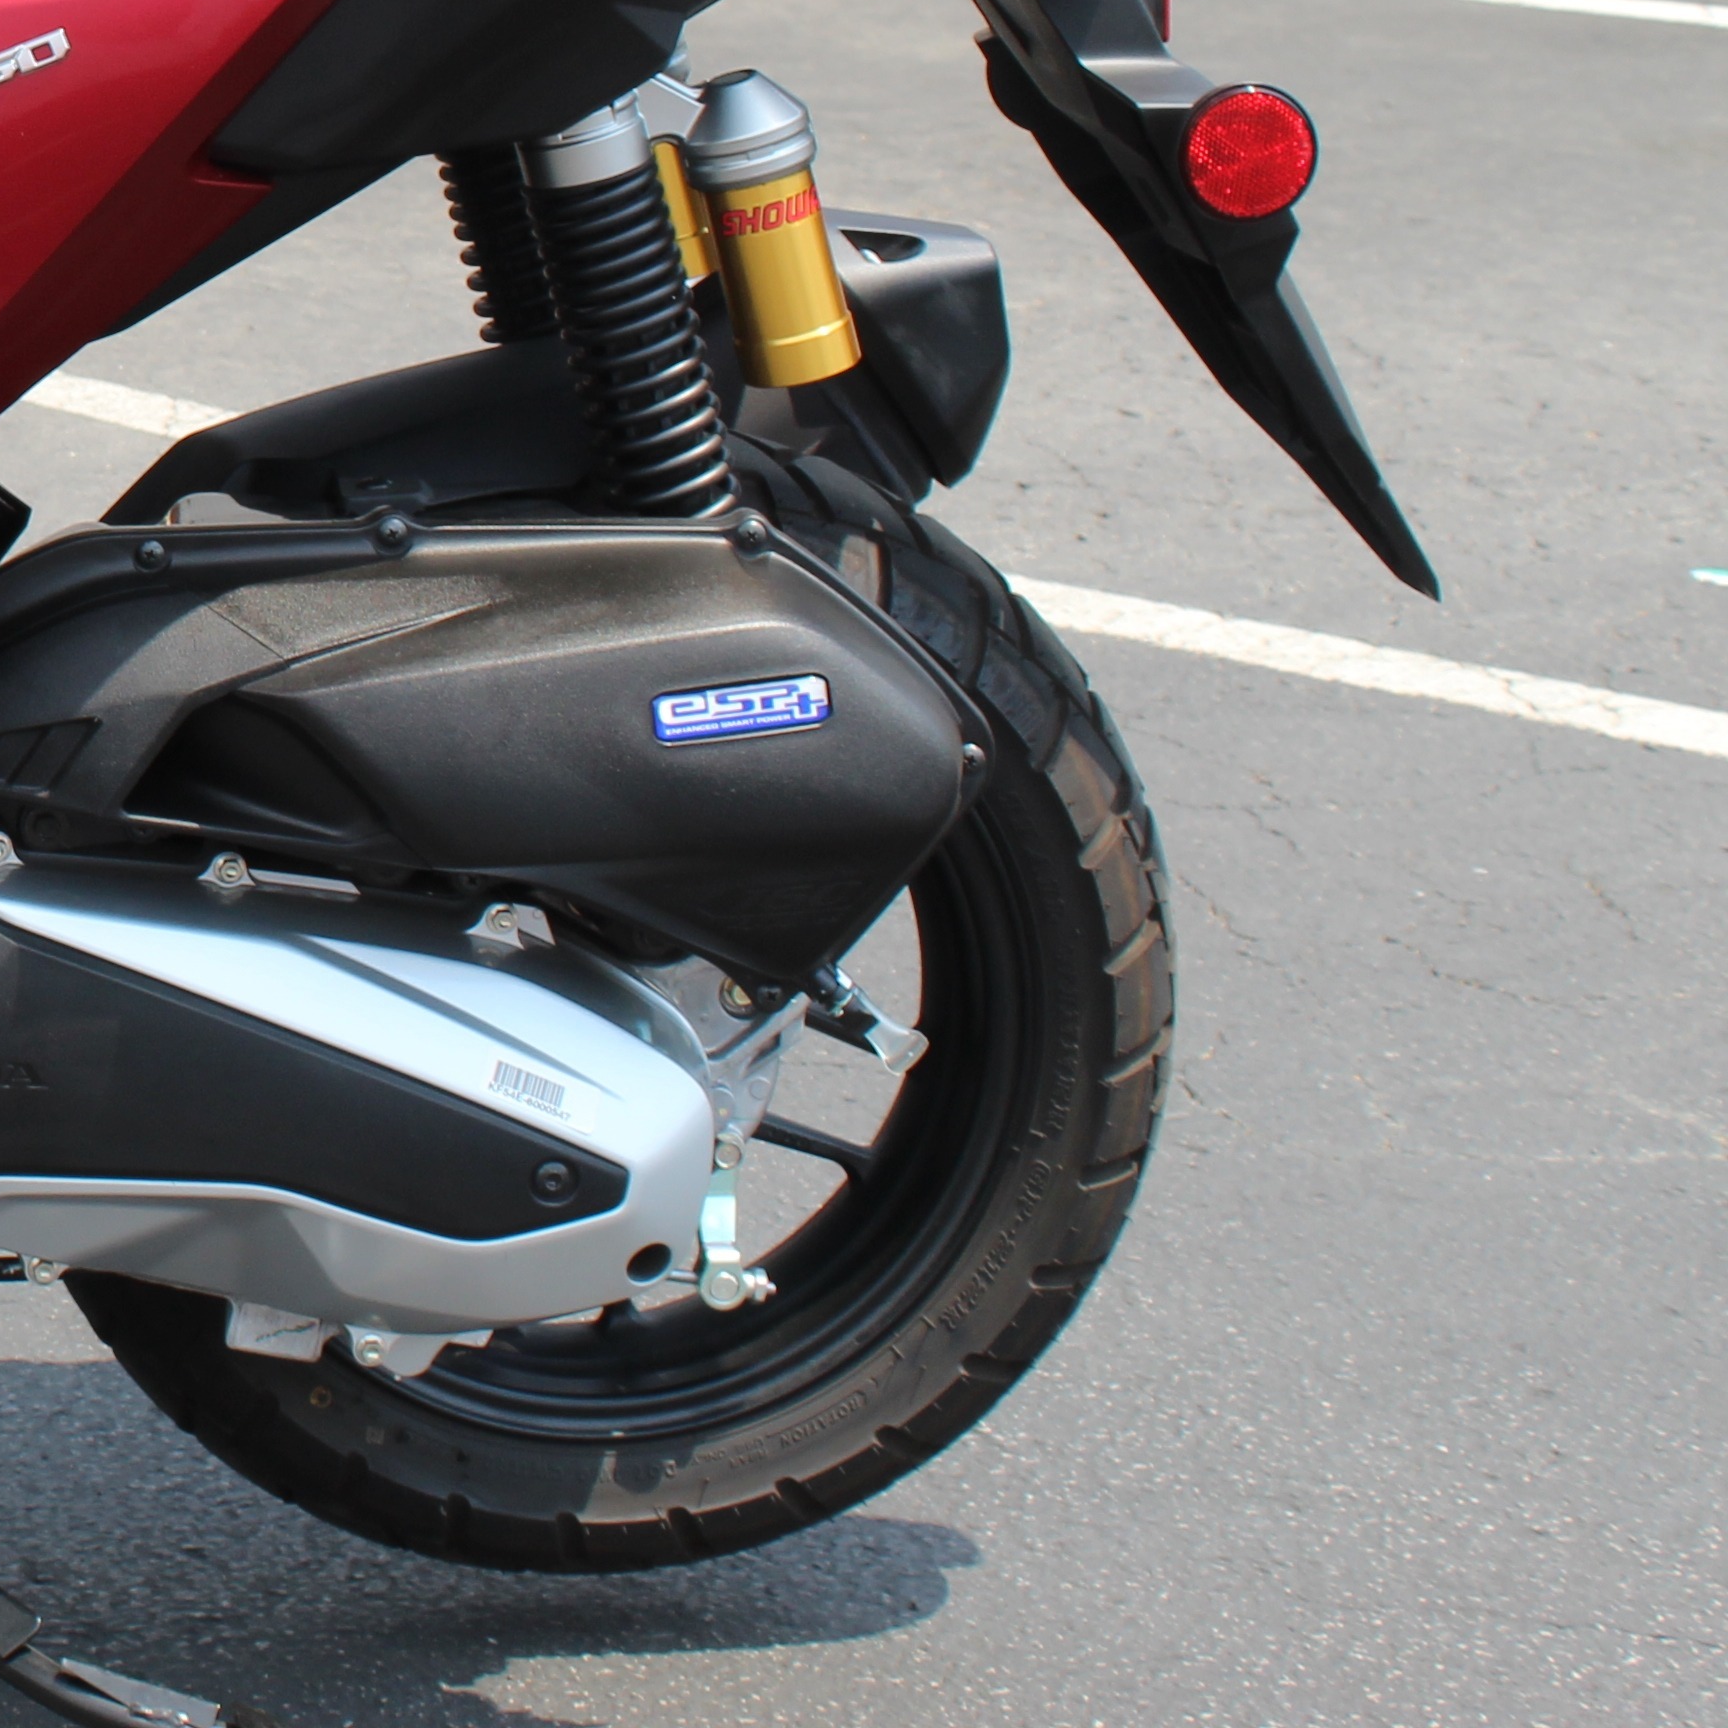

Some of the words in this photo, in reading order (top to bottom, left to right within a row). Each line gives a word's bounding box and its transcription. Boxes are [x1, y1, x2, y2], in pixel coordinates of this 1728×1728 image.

[665, 722, 719, 736] ENHANCED
[721, 717, 756, 729] SMART
[756, 713, 791, 725] POWER
[776, 1392, 864, 1449] ROTATION
